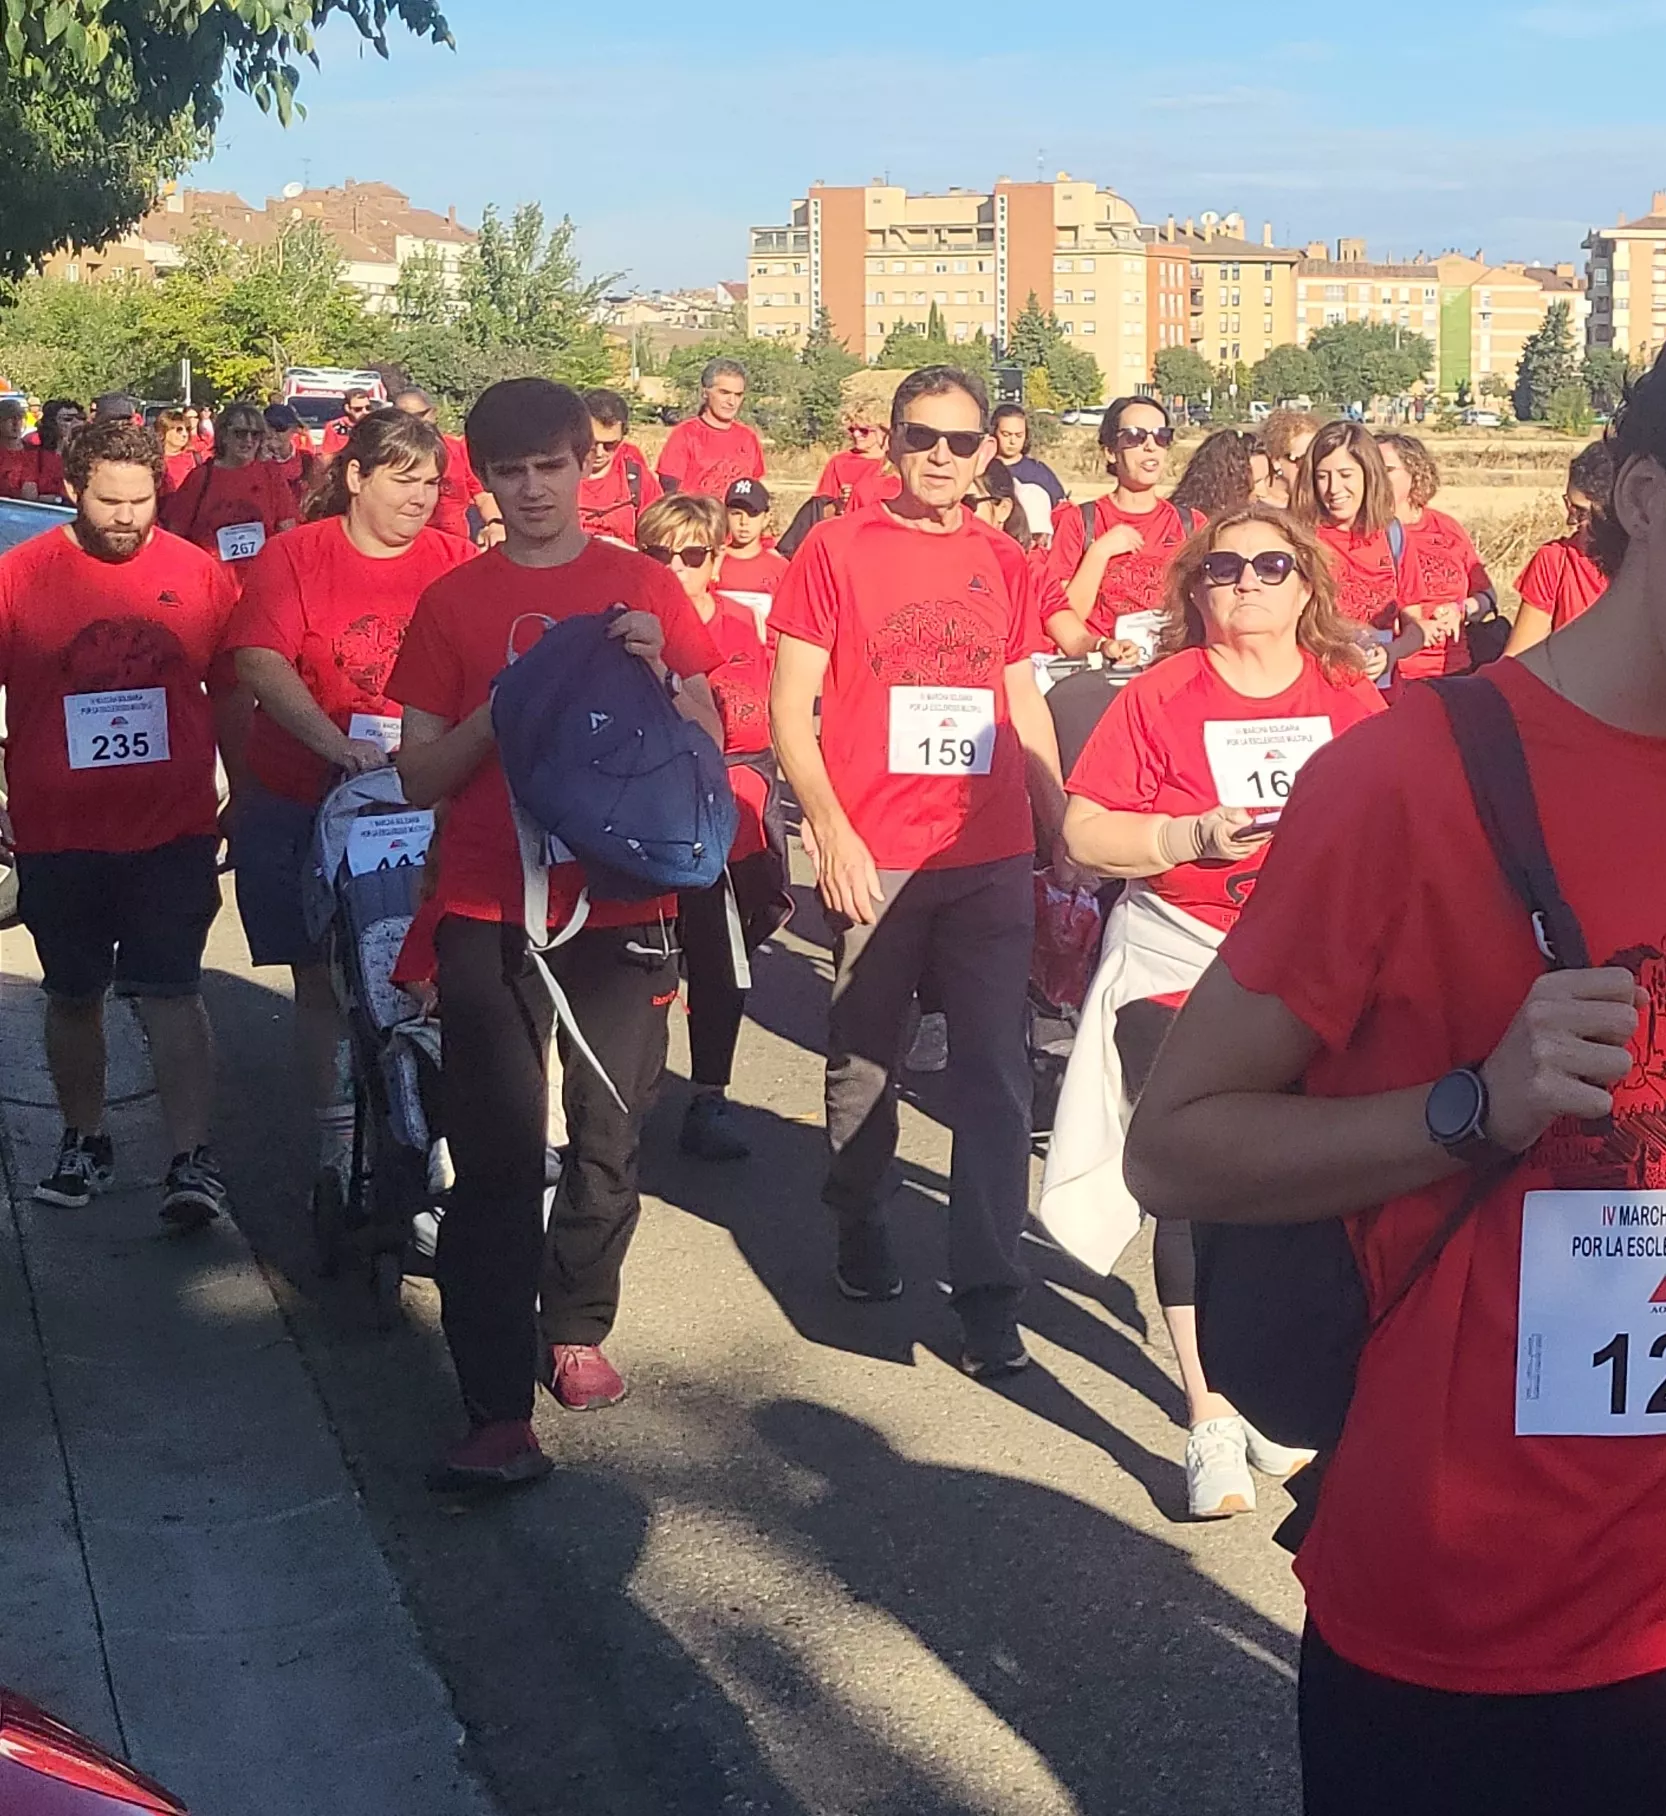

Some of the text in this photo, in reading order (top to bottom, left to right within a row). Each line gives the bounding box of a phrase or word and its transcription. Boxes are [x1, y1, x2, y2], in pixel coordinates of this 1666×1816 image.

[230, 541, 256, 556] 267
[92, 731, 149, 761] 235
[918, 737, 976, 767] 159
[1247, 770, 1291, 798] 16
[1603, 1204, 1617, 1226] IV
[1572, 1236, 1602, 1257] POR
[1606, 1235, 1623, 1257] LA
